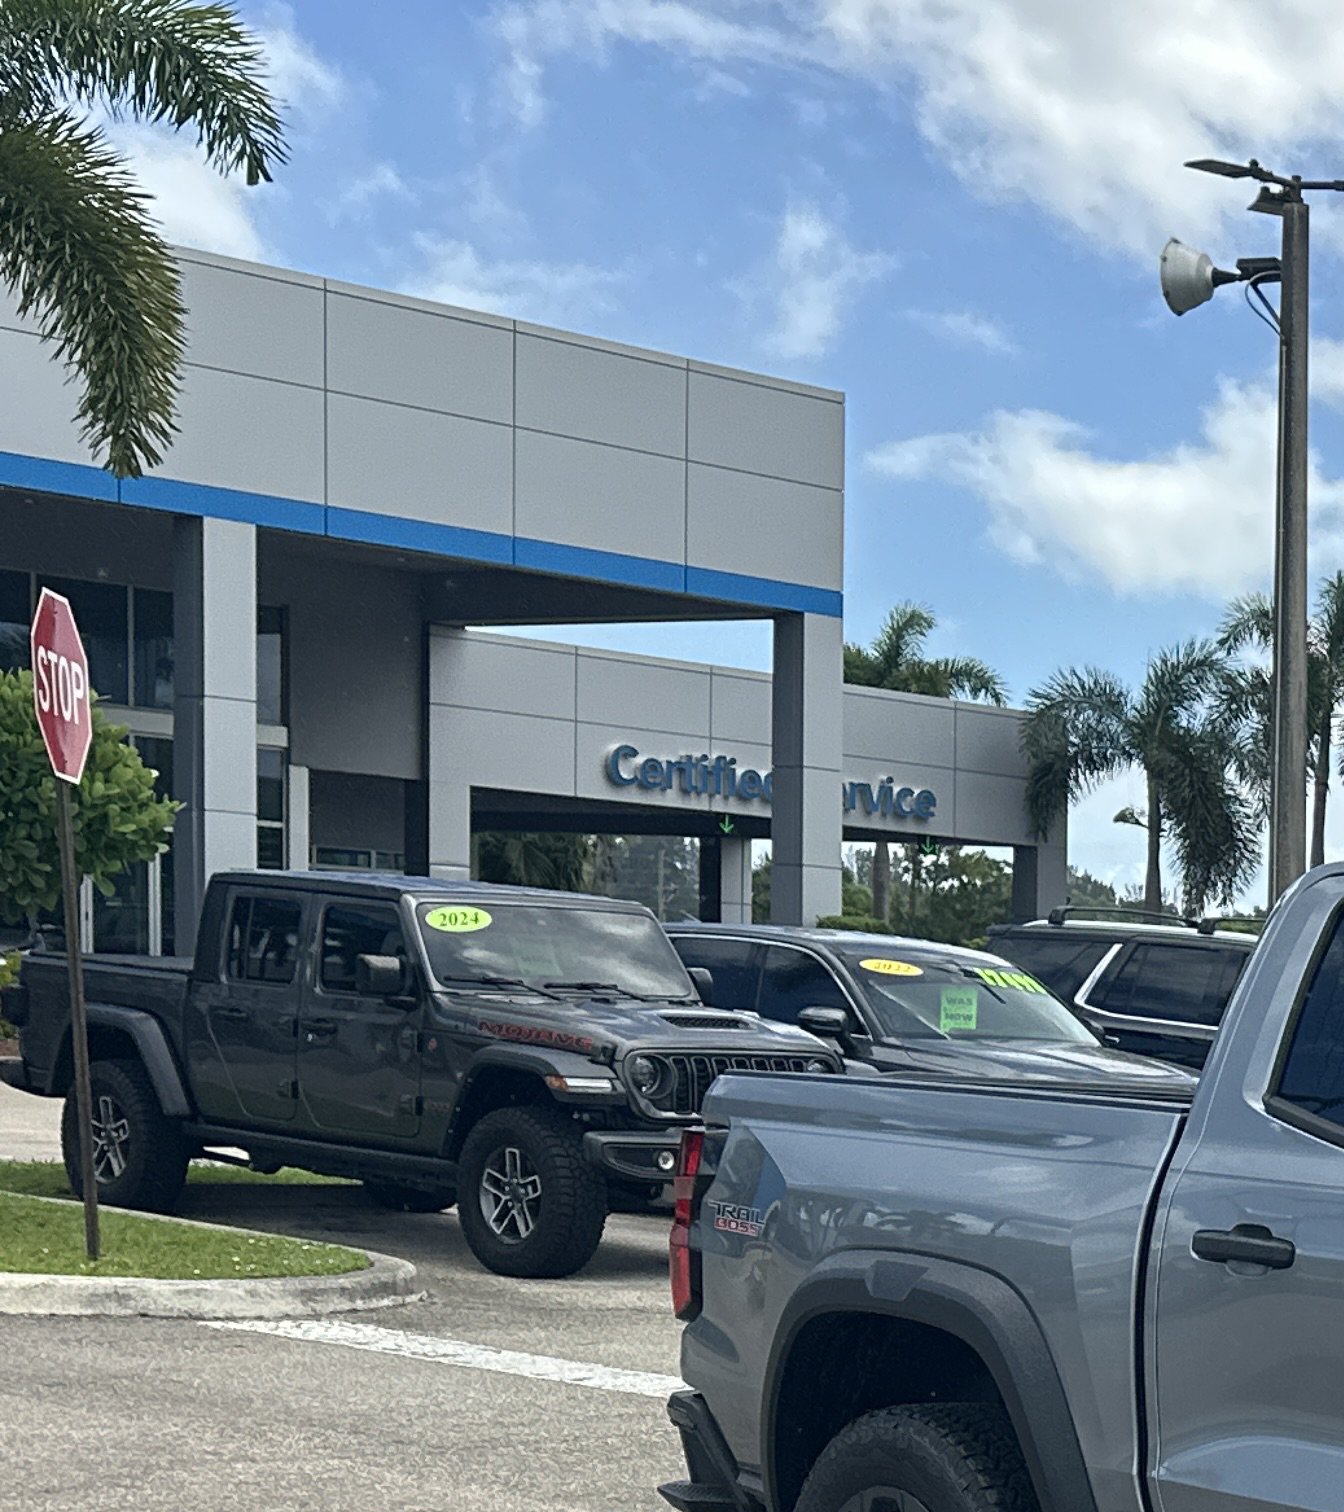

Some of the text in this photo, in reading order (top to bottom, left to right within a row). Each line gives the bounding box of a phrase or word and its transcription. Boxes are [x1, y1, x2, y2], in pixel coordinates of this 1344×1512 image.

[36, 644, 84, 726] STOP
[607, 744, 938, 820] Certifie rvice
[438, 911, 480, 927] 2024
[707, 1200, 766, 1226] TRAIL
[714, 1217, 760, 1237] BOSS
